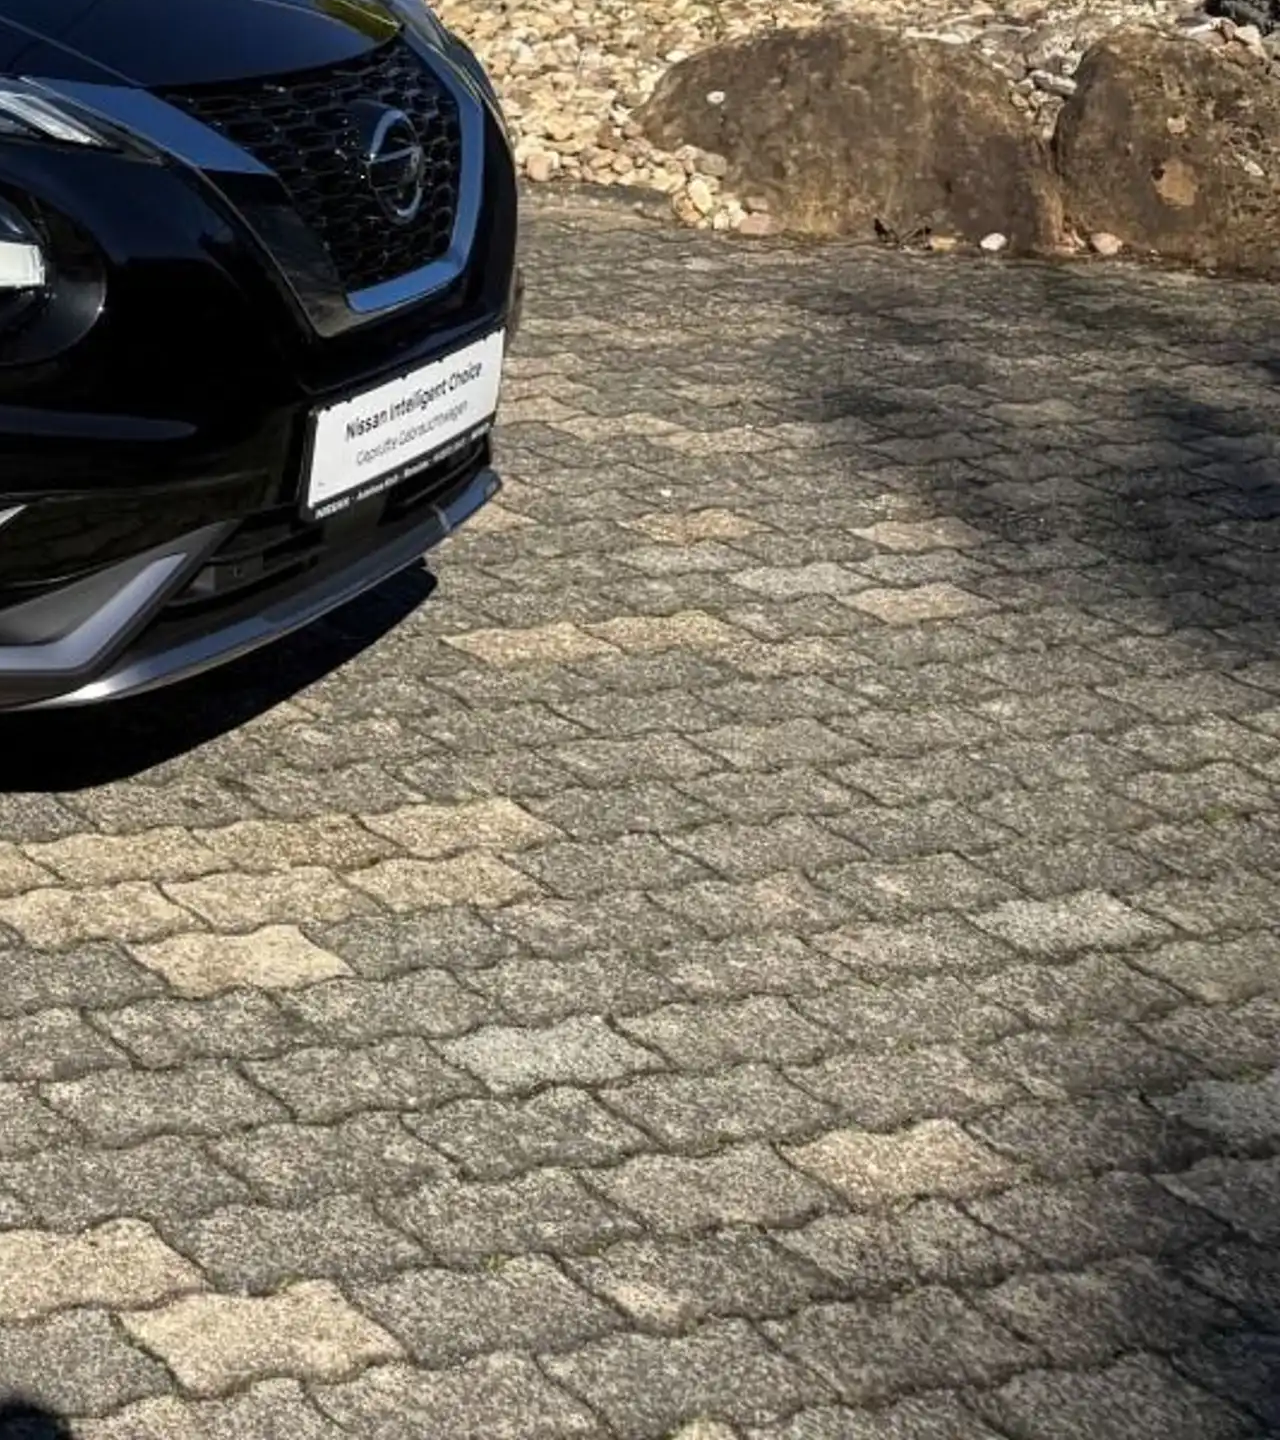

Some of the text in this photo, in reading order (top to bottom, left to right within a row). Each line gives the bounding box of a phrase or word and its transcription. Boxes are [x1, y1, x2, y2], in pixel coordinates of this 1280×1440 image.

[346, 362, 482, 441] Nissan Intelligent Choice
